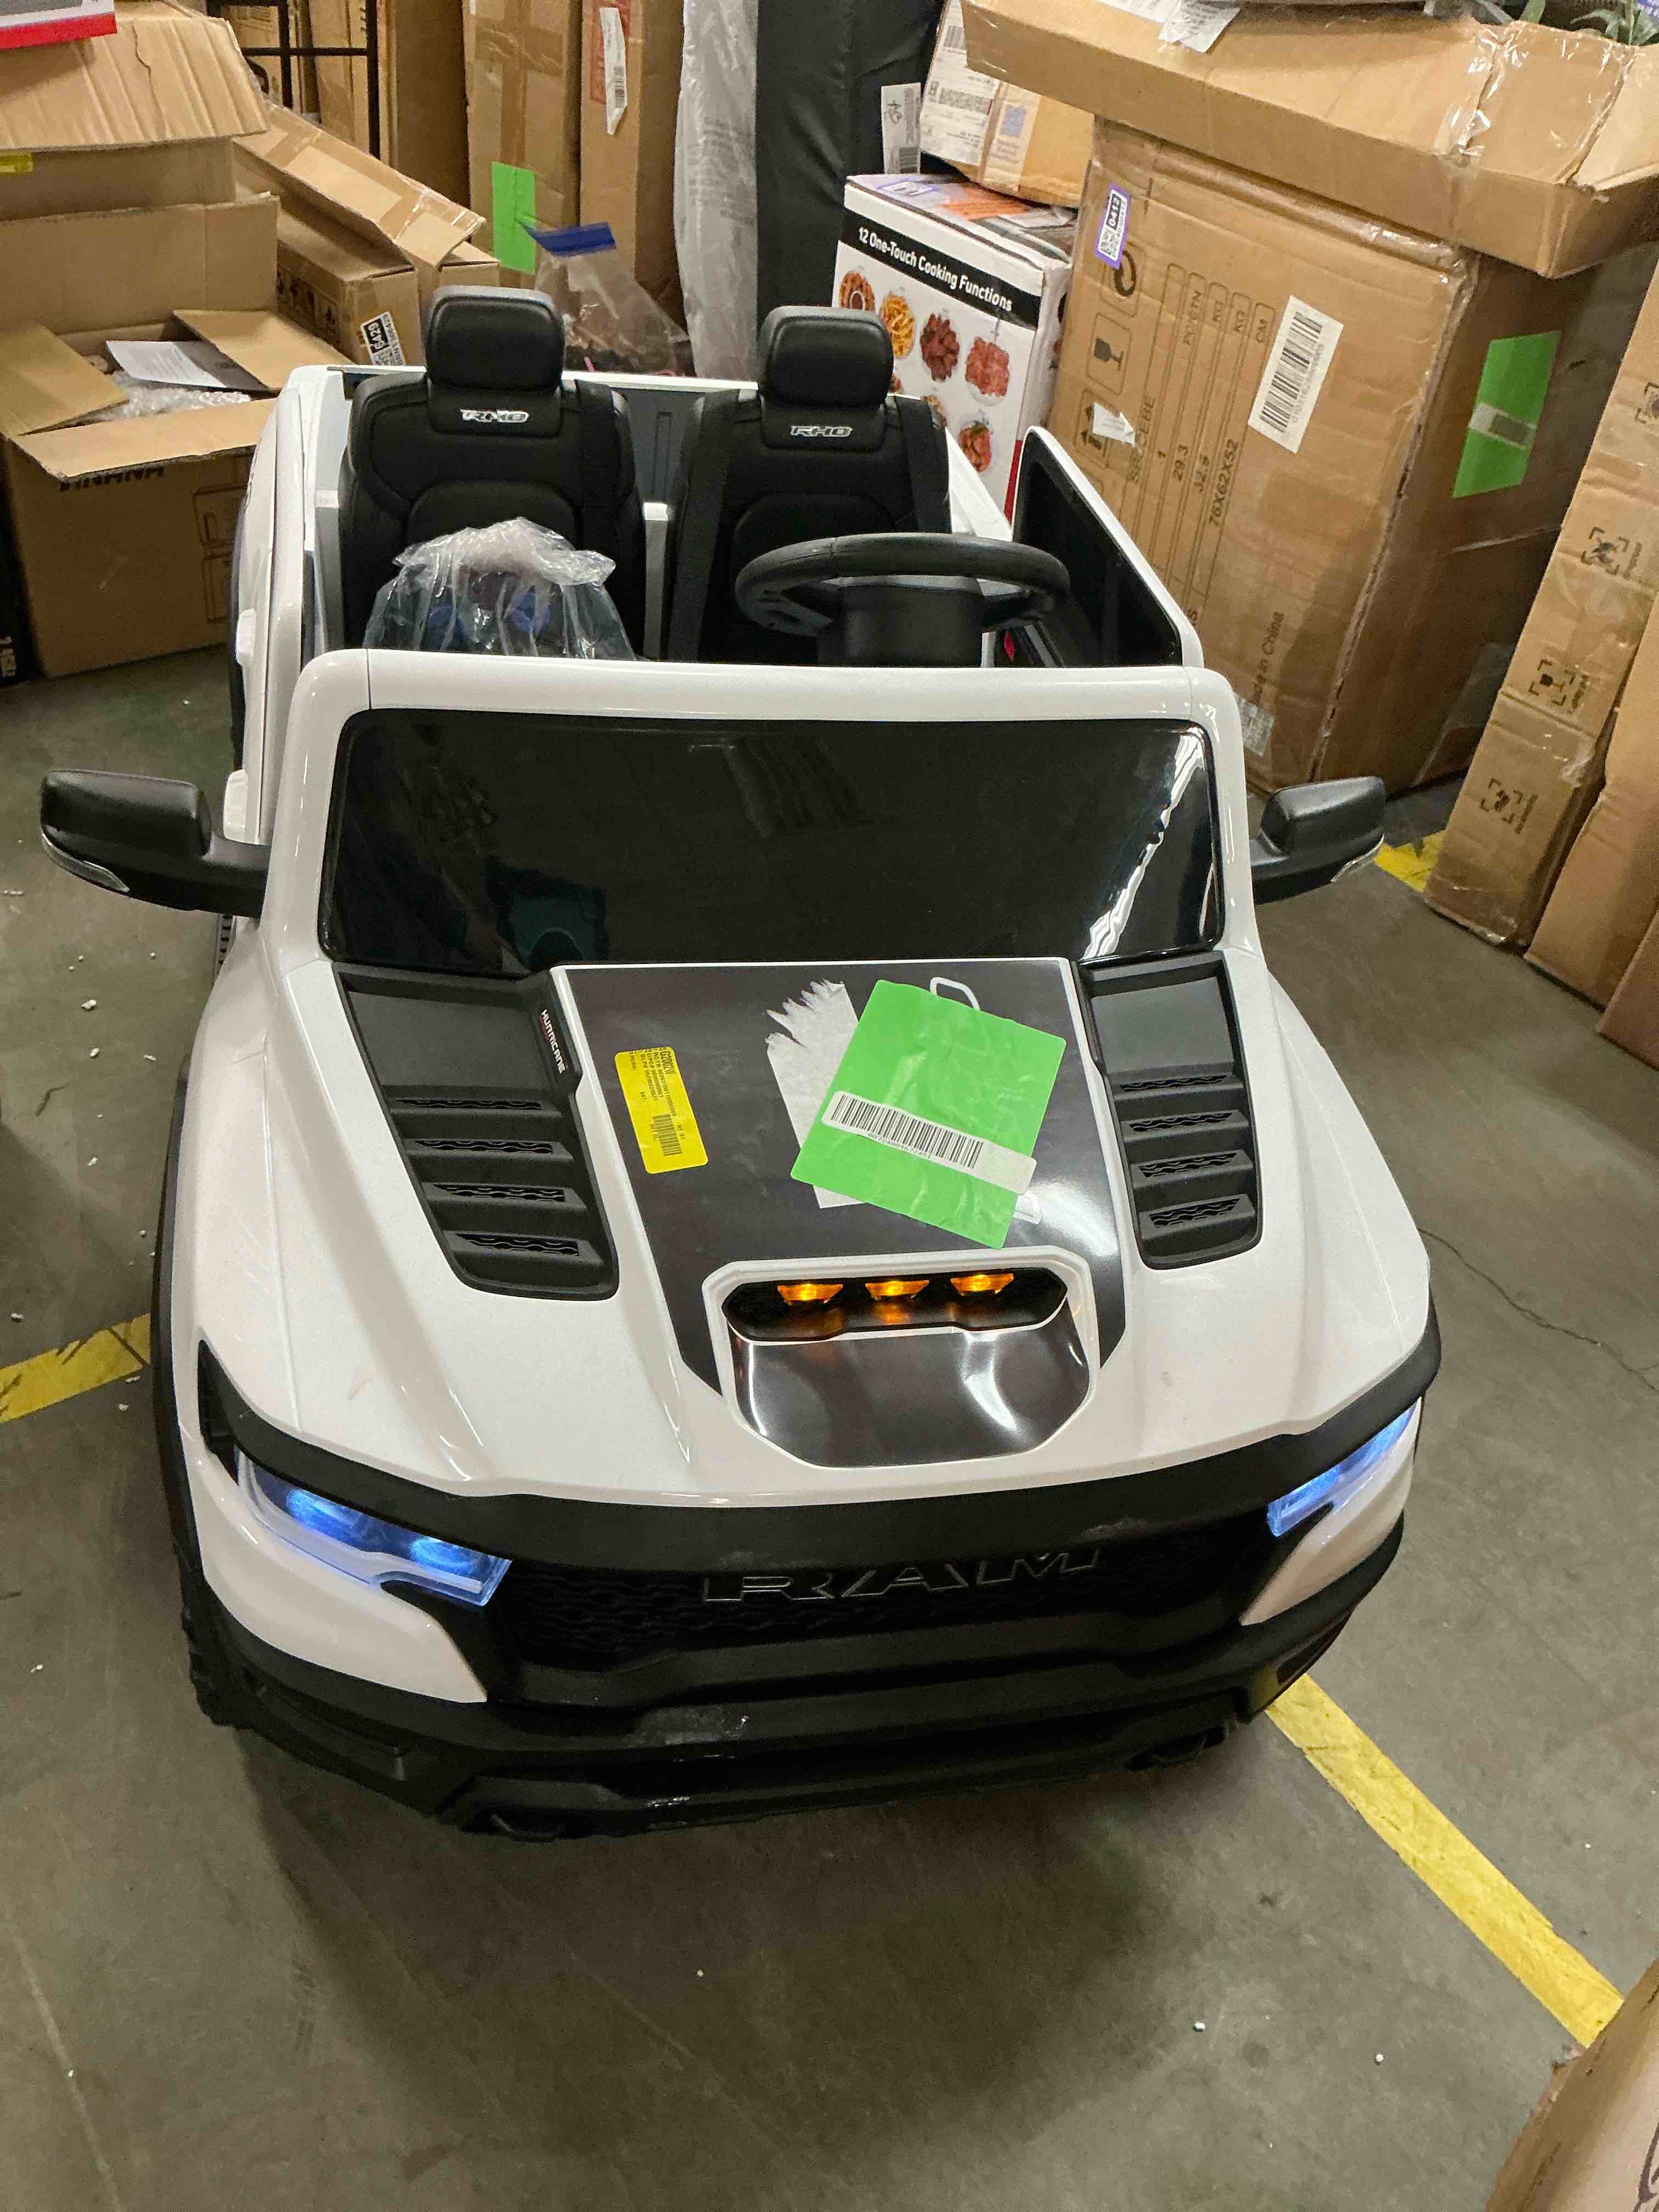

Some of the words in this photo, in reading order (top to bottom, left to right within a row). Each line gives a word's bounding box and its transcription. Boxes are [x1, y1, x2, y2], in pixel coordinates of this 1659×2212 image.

[859, 227, 869, 244] 12
[870, 233, 917, 267] One-Touch
[918, 256, 958, 290] Cooking
[959, 275, 1012, 311] Functions
[1261, 611, 1284, 655] China
[541, 1009, 566, 1074] HURRICANE
[703, 1549, 1099, 1602] RAM
